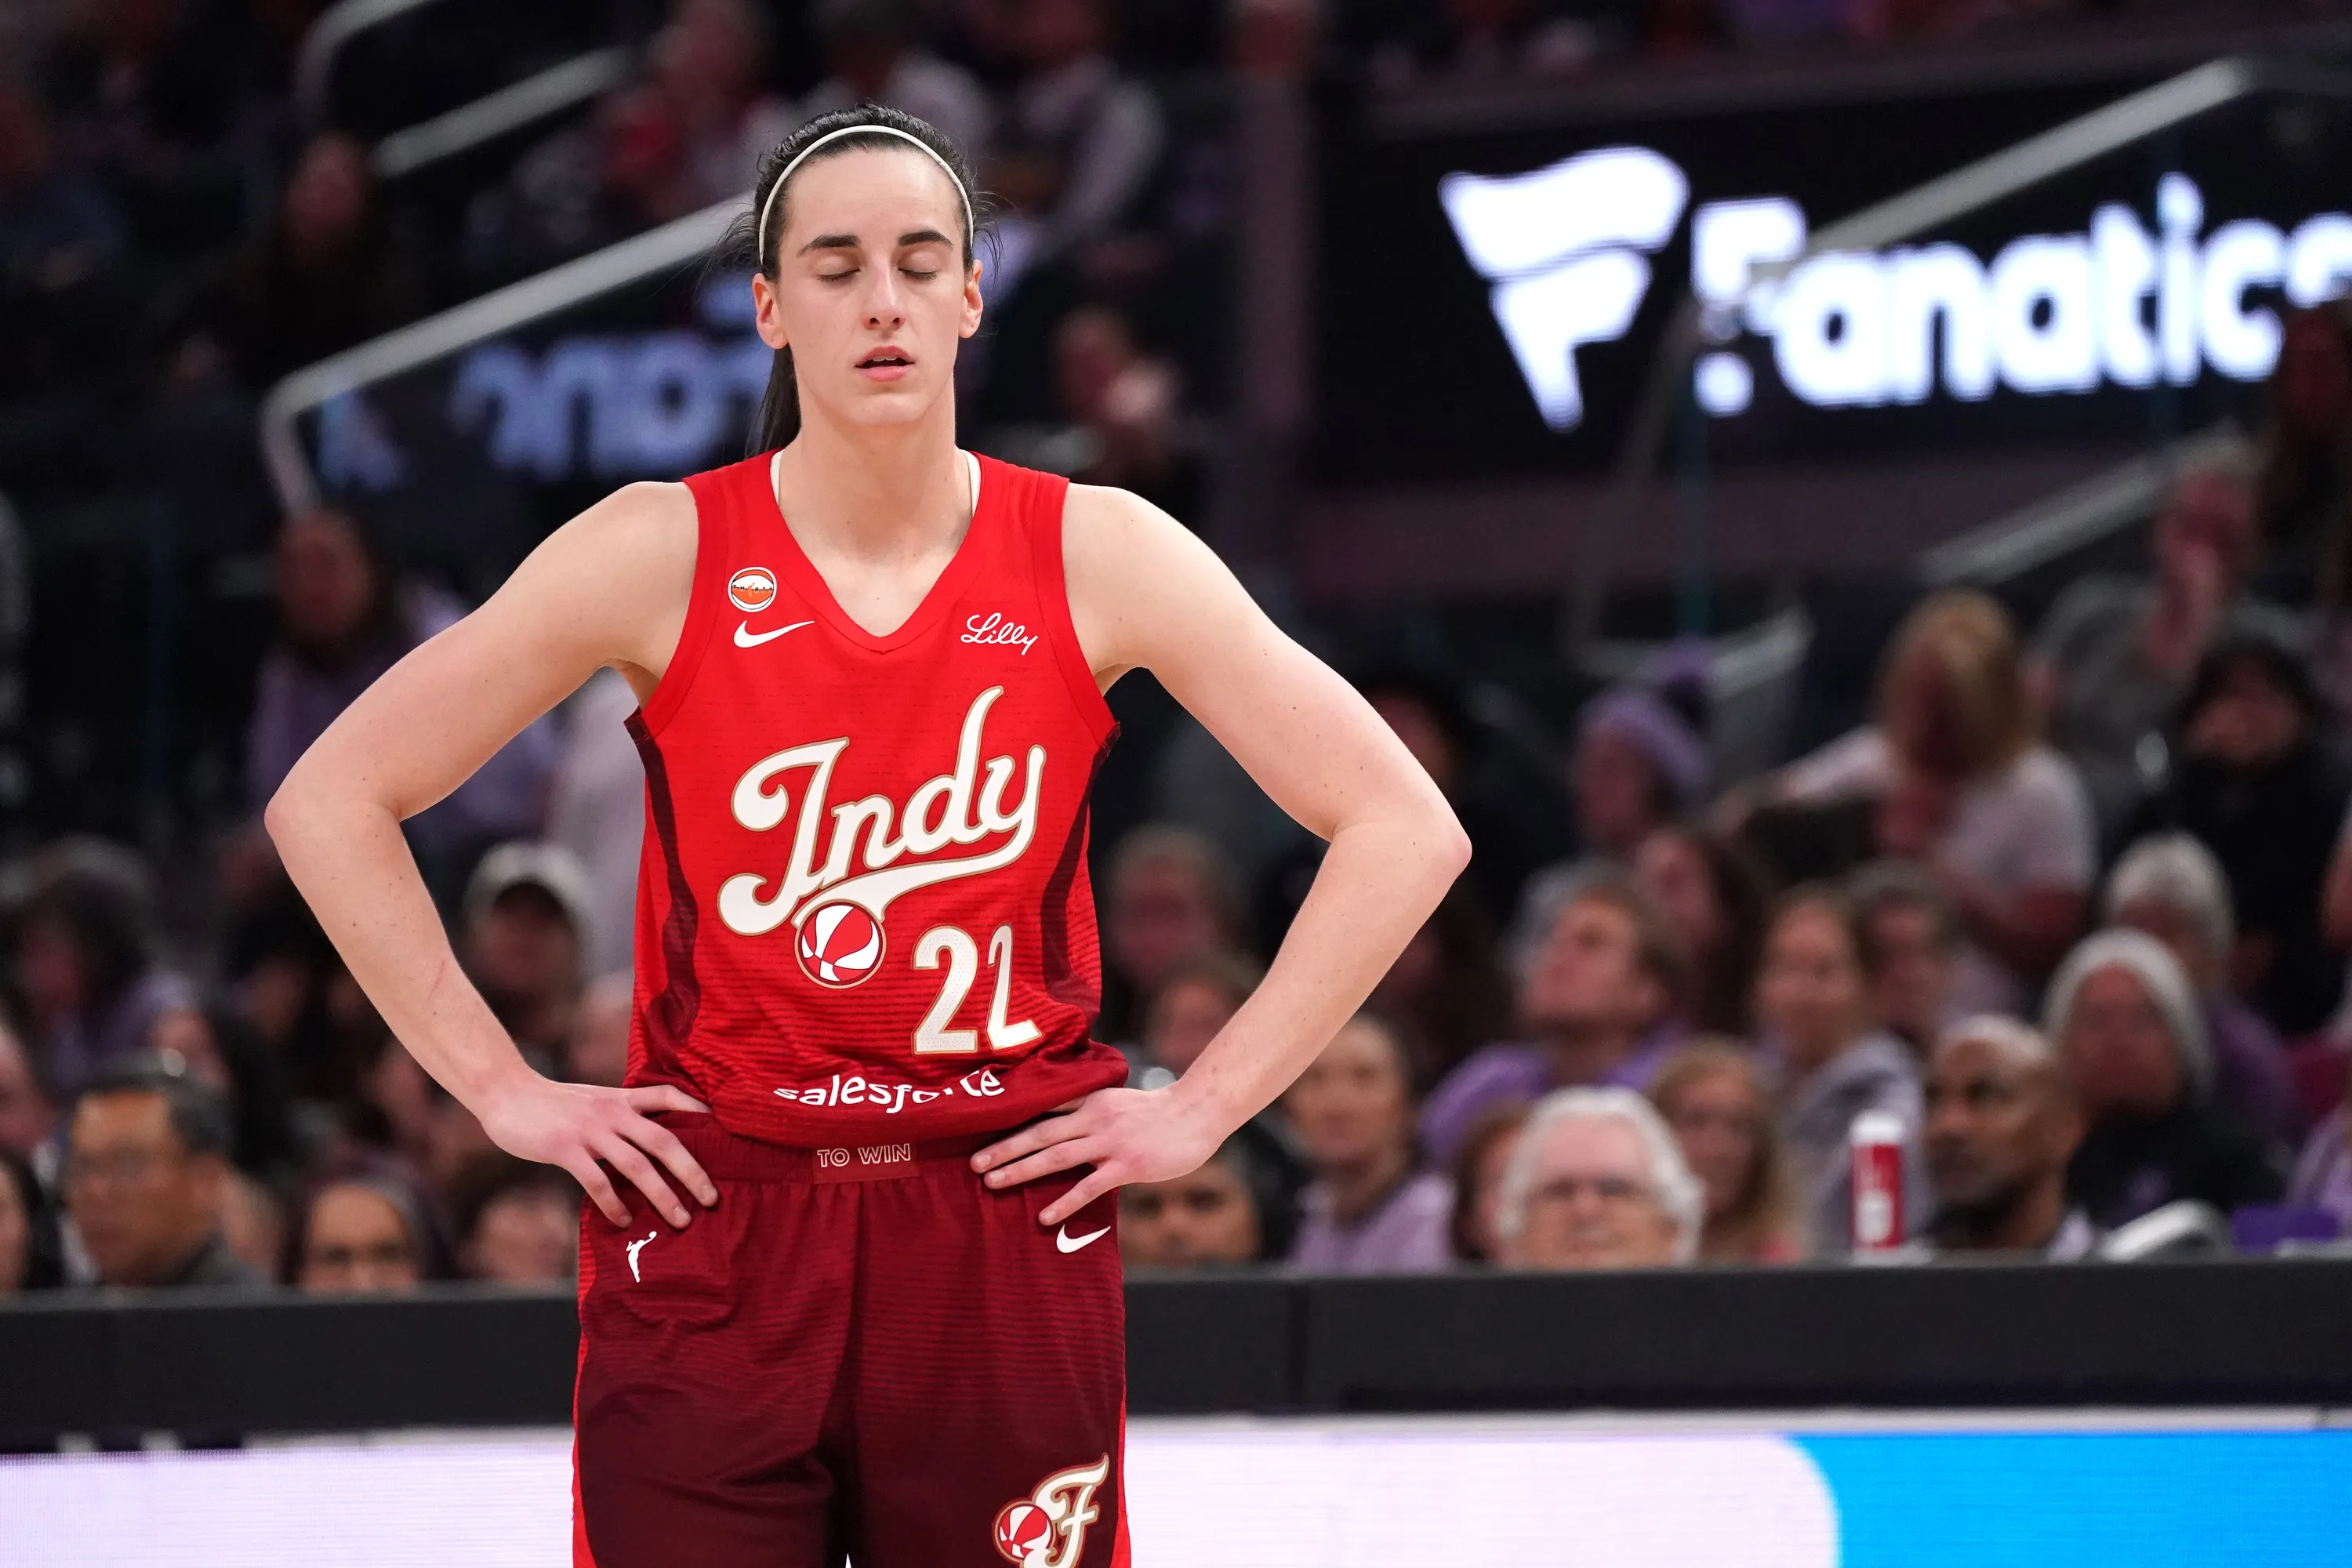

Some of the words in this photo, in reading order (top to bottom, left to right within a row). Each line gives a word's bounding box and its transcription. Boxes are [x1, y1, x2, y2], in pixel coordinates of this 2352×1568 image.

[960, 612, 1039, 656] Lilly
[717, 685, 1047, 936] Indy
[773, 1069, 1005, 1113] salesfoce
[817, 1148, 850, 1167] TO
[858, 1143, 911, 1165] WIN
